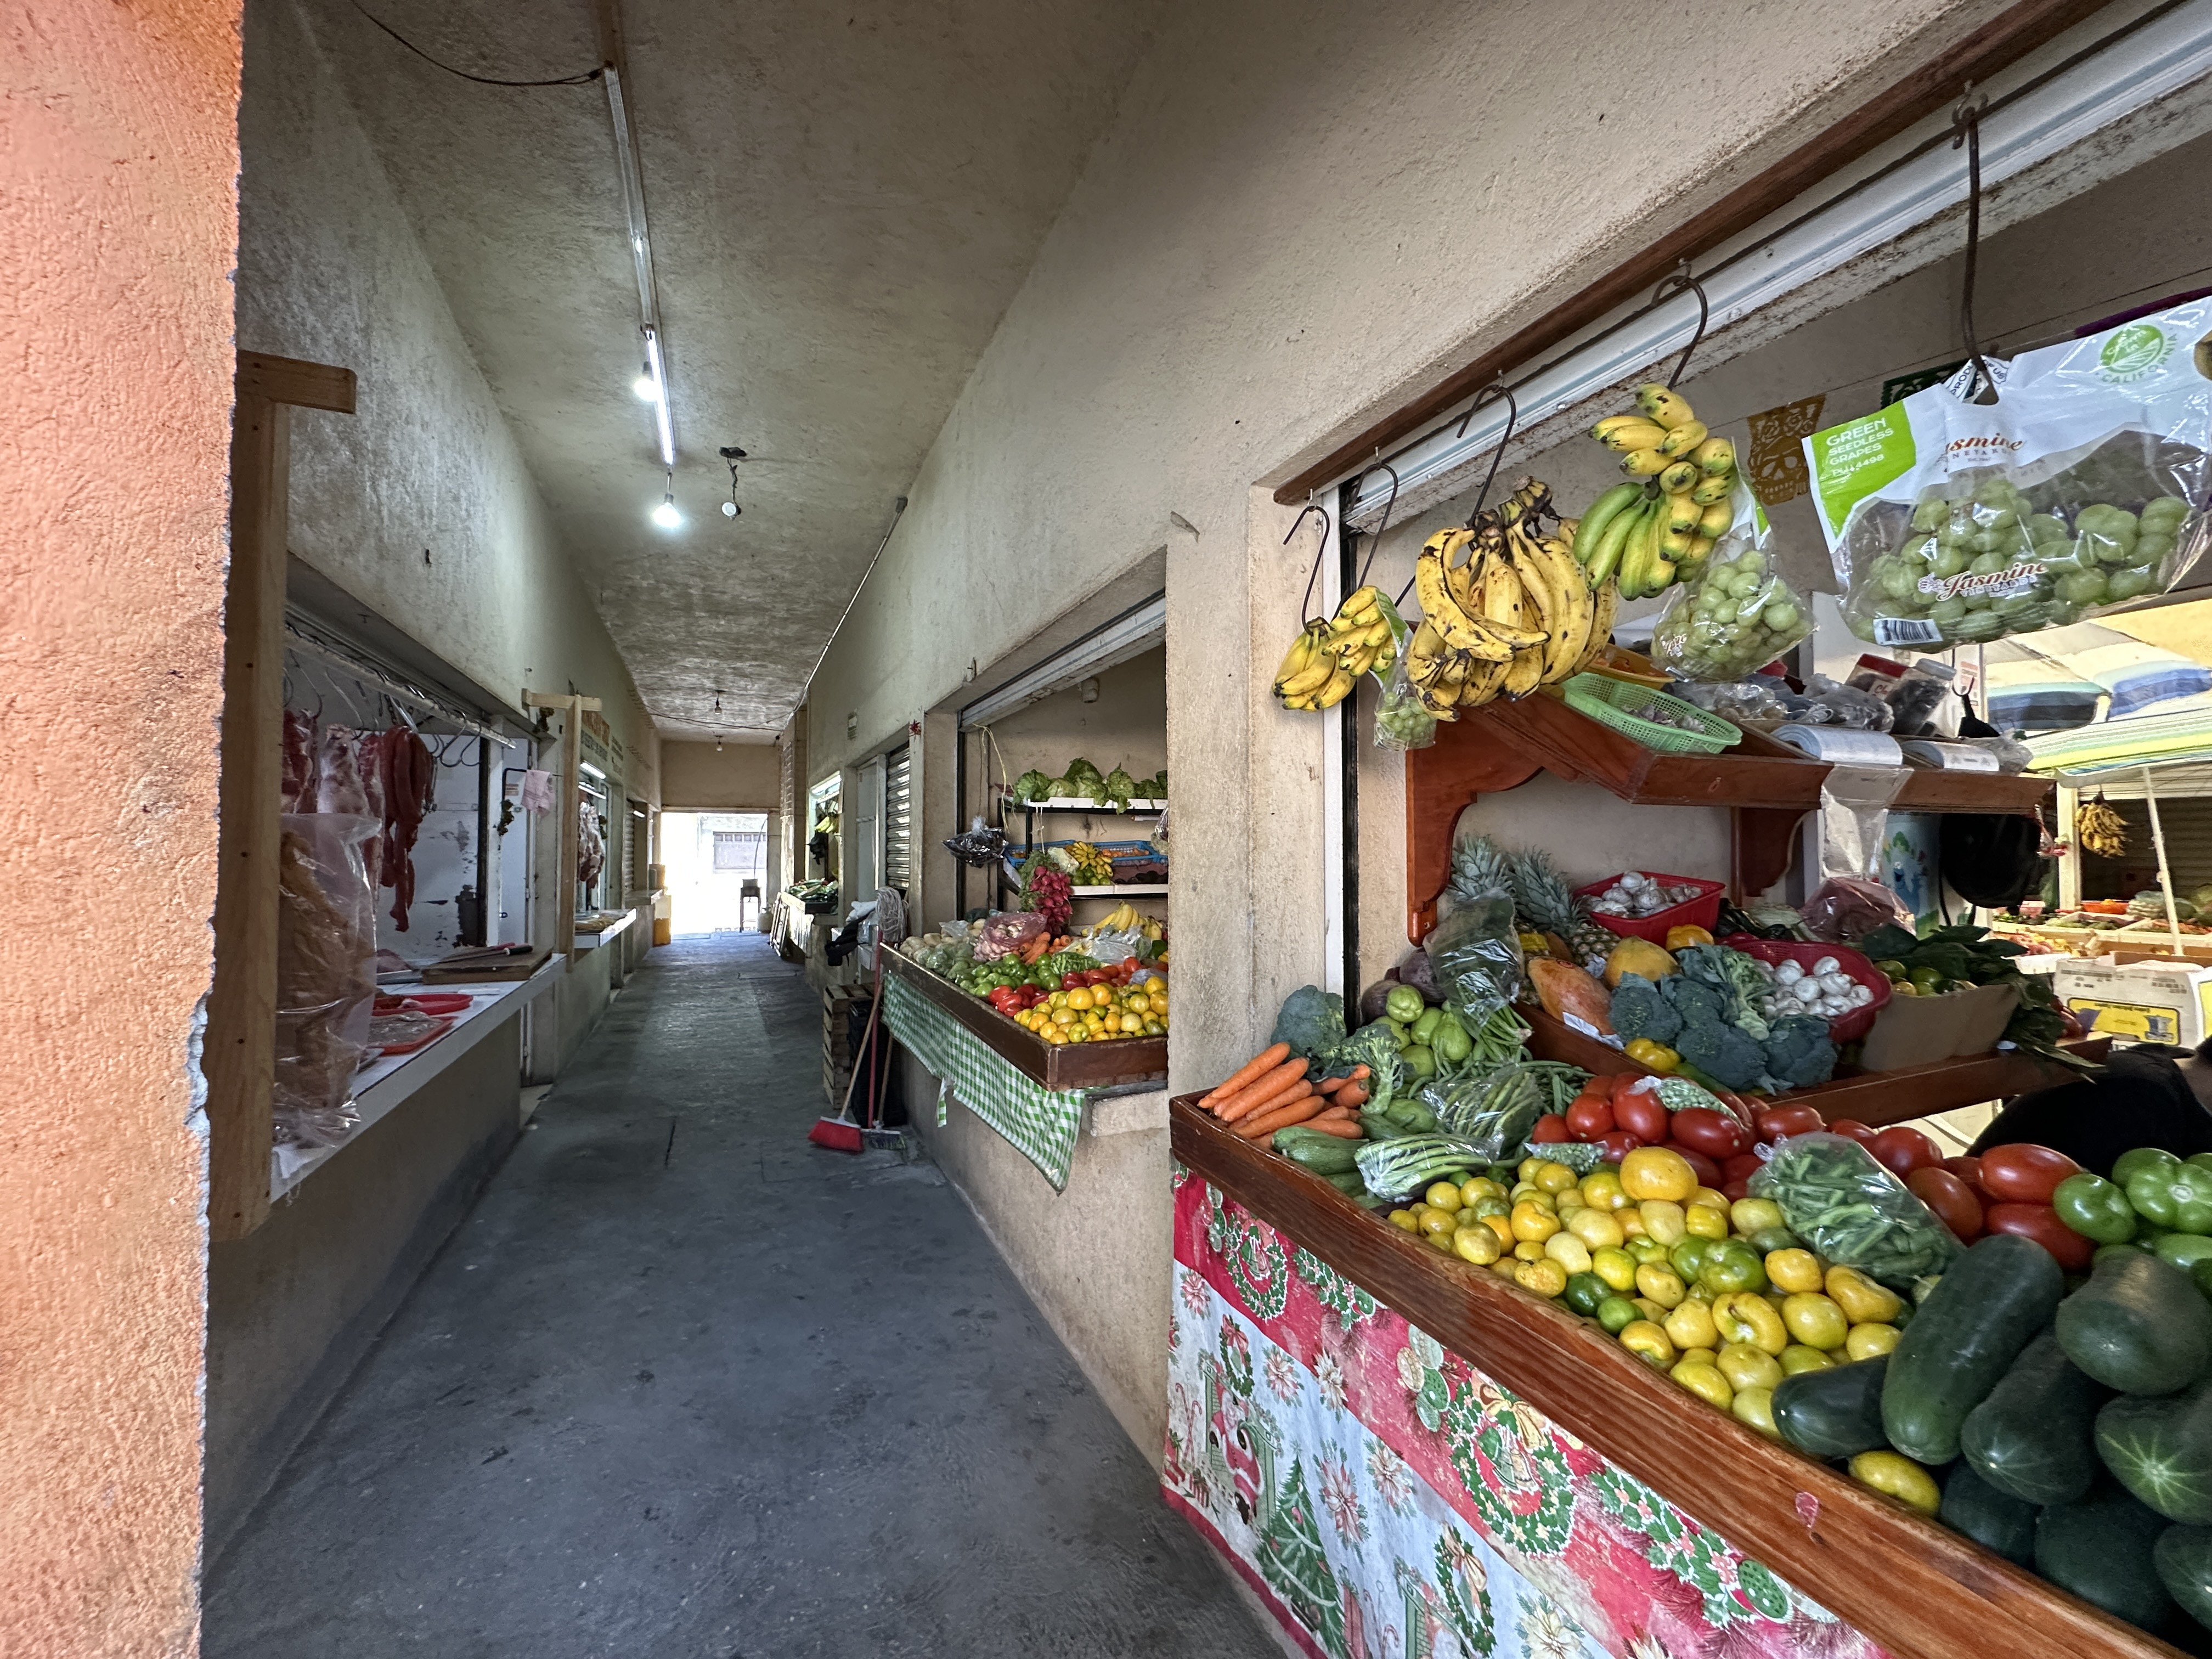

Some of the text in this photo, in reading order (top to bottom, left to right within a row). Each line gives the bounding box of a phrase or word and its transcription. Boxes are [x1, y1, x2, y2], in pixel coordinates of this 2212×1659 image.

[2101, 334, 2177, 383] CALIFORNIA
[1826, 417, 1886, 446] GREEN
[1829, 428, 1894, 455] SEEDLESS
[1830, 443, 1882, 465] GRAPES
[1855, 454, 1884, 469] 4498
[1936, 562, 2049, 601] Jasmine
